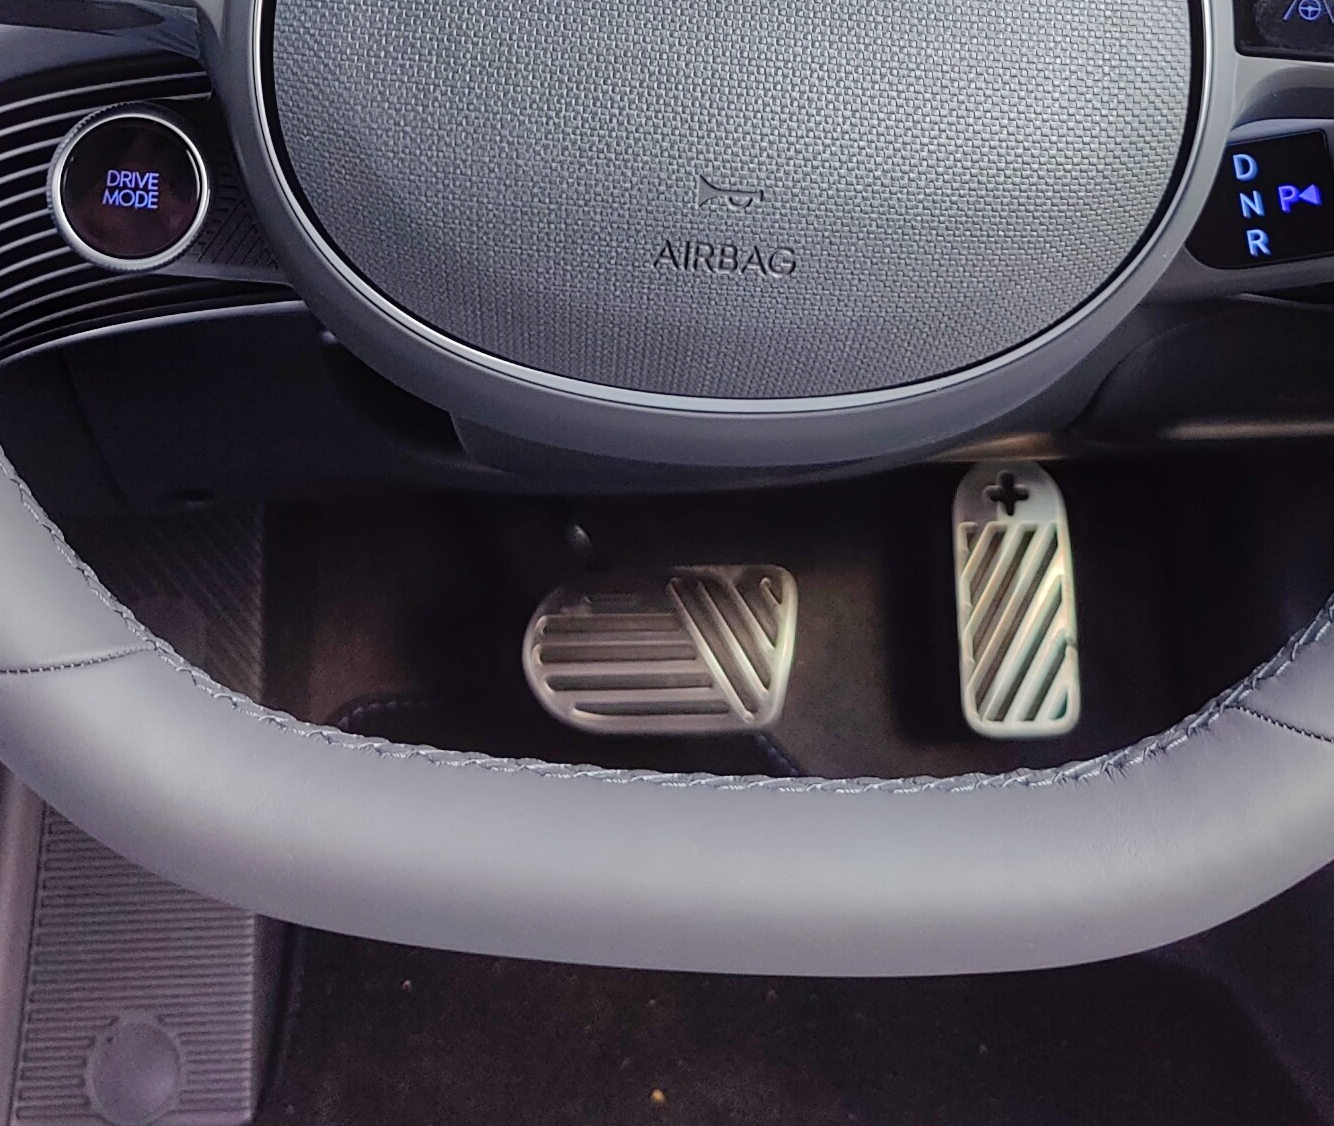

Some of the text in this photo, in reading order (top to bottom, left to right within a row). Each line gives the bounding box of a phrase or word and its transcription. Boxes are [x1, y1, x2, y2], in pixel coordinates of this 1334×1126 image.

[105, 169, 160, 191] DRIVE
[1232, 153, 1259, 181] D
[101, 188, 160, 210] MODE
[1239, 190, 1266, 219] N
[1277, 185, 1300, 214] P
[1246, 229, 1272, 257] R
[652, 238, 798, 278] AIRBAG
